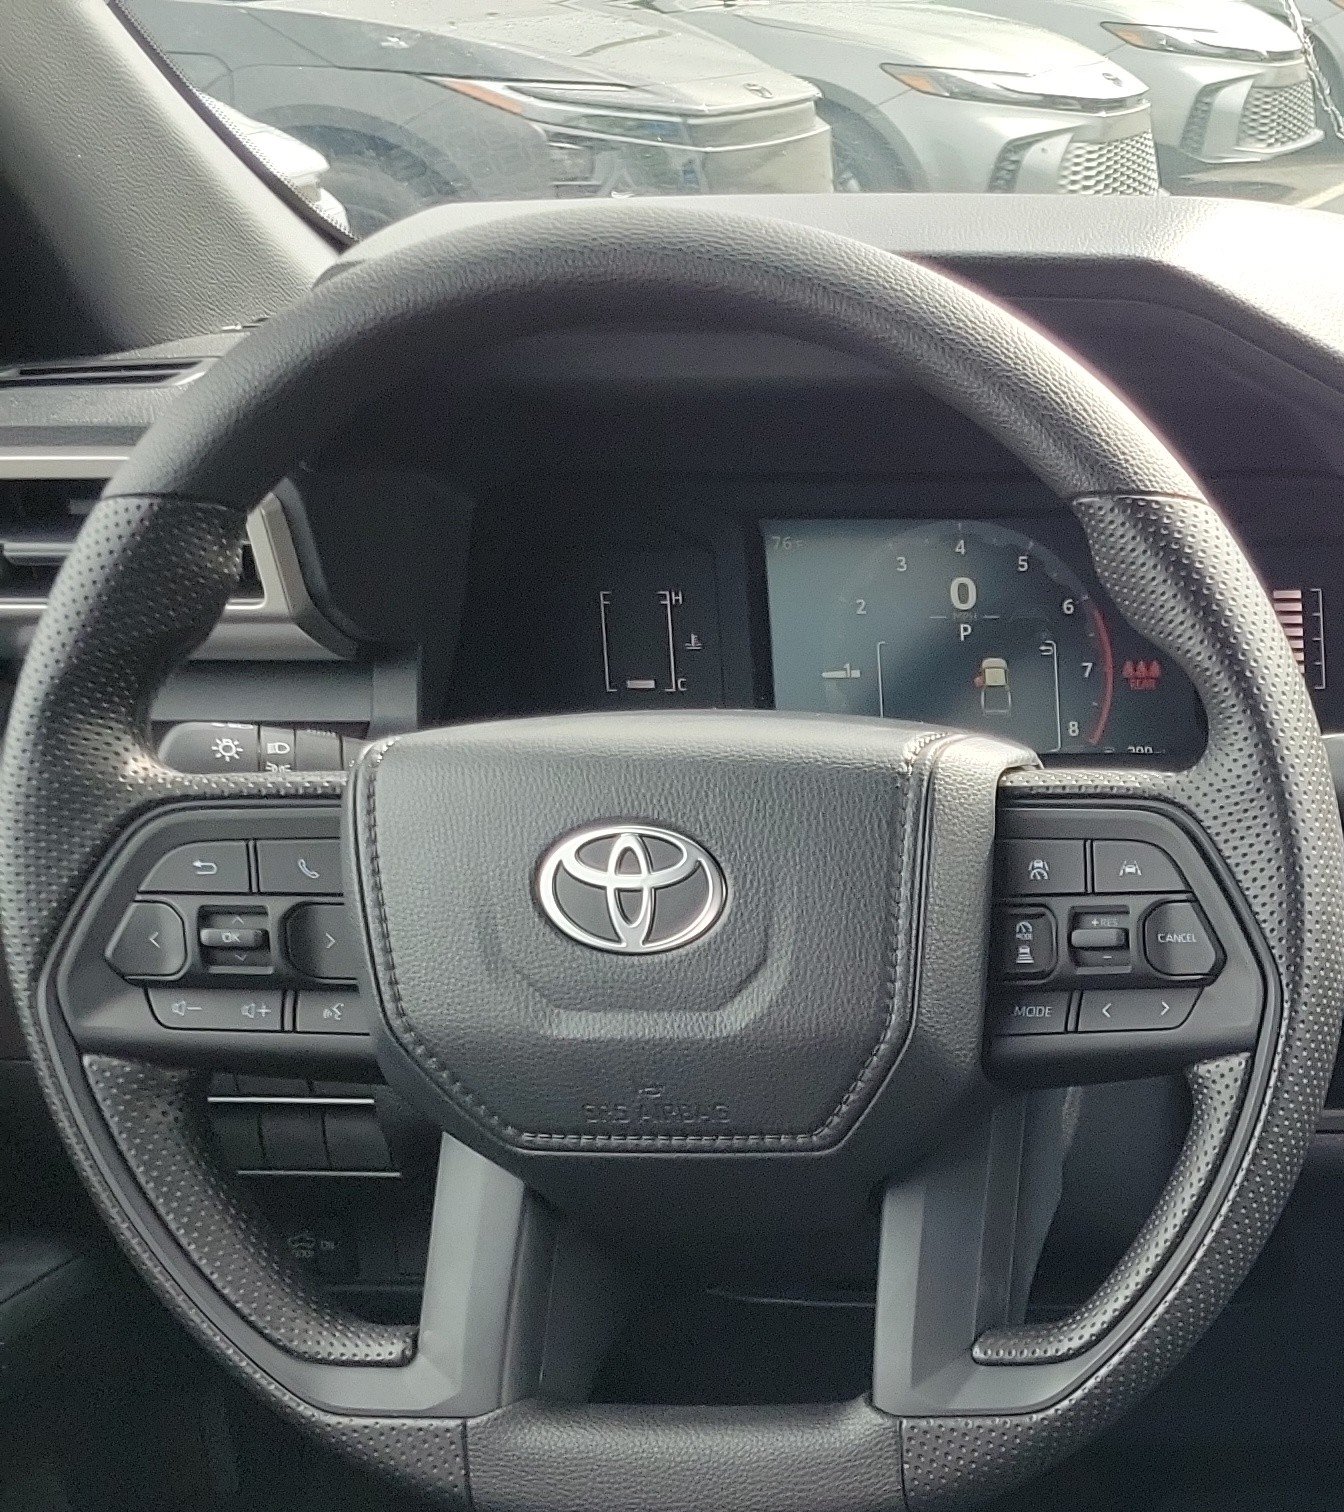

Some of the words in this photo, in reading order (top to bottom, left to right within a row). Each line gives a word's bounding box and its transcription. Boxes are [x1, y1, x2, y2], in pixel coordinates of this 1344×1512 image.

[955, 540, 966, 555] 4
[896, 557, 907, 572] 3
[1017, 556, 1029, 571] 5
[671, 590, 683, 605] H
[951, 577, 977, 610] 0
[856, 599, 867, 615] 2
[1063, 599, 1075, 615] 6
[960, 624, 972, 641] P
[1082, 662, 1093, 678] 7
[677, 678, 687, 691] C
[1068, 721, 1080, 736] 8
[1157, 933, 1197, 944] CANCEL
[1013, 1006, 1052, 1018] MODE
